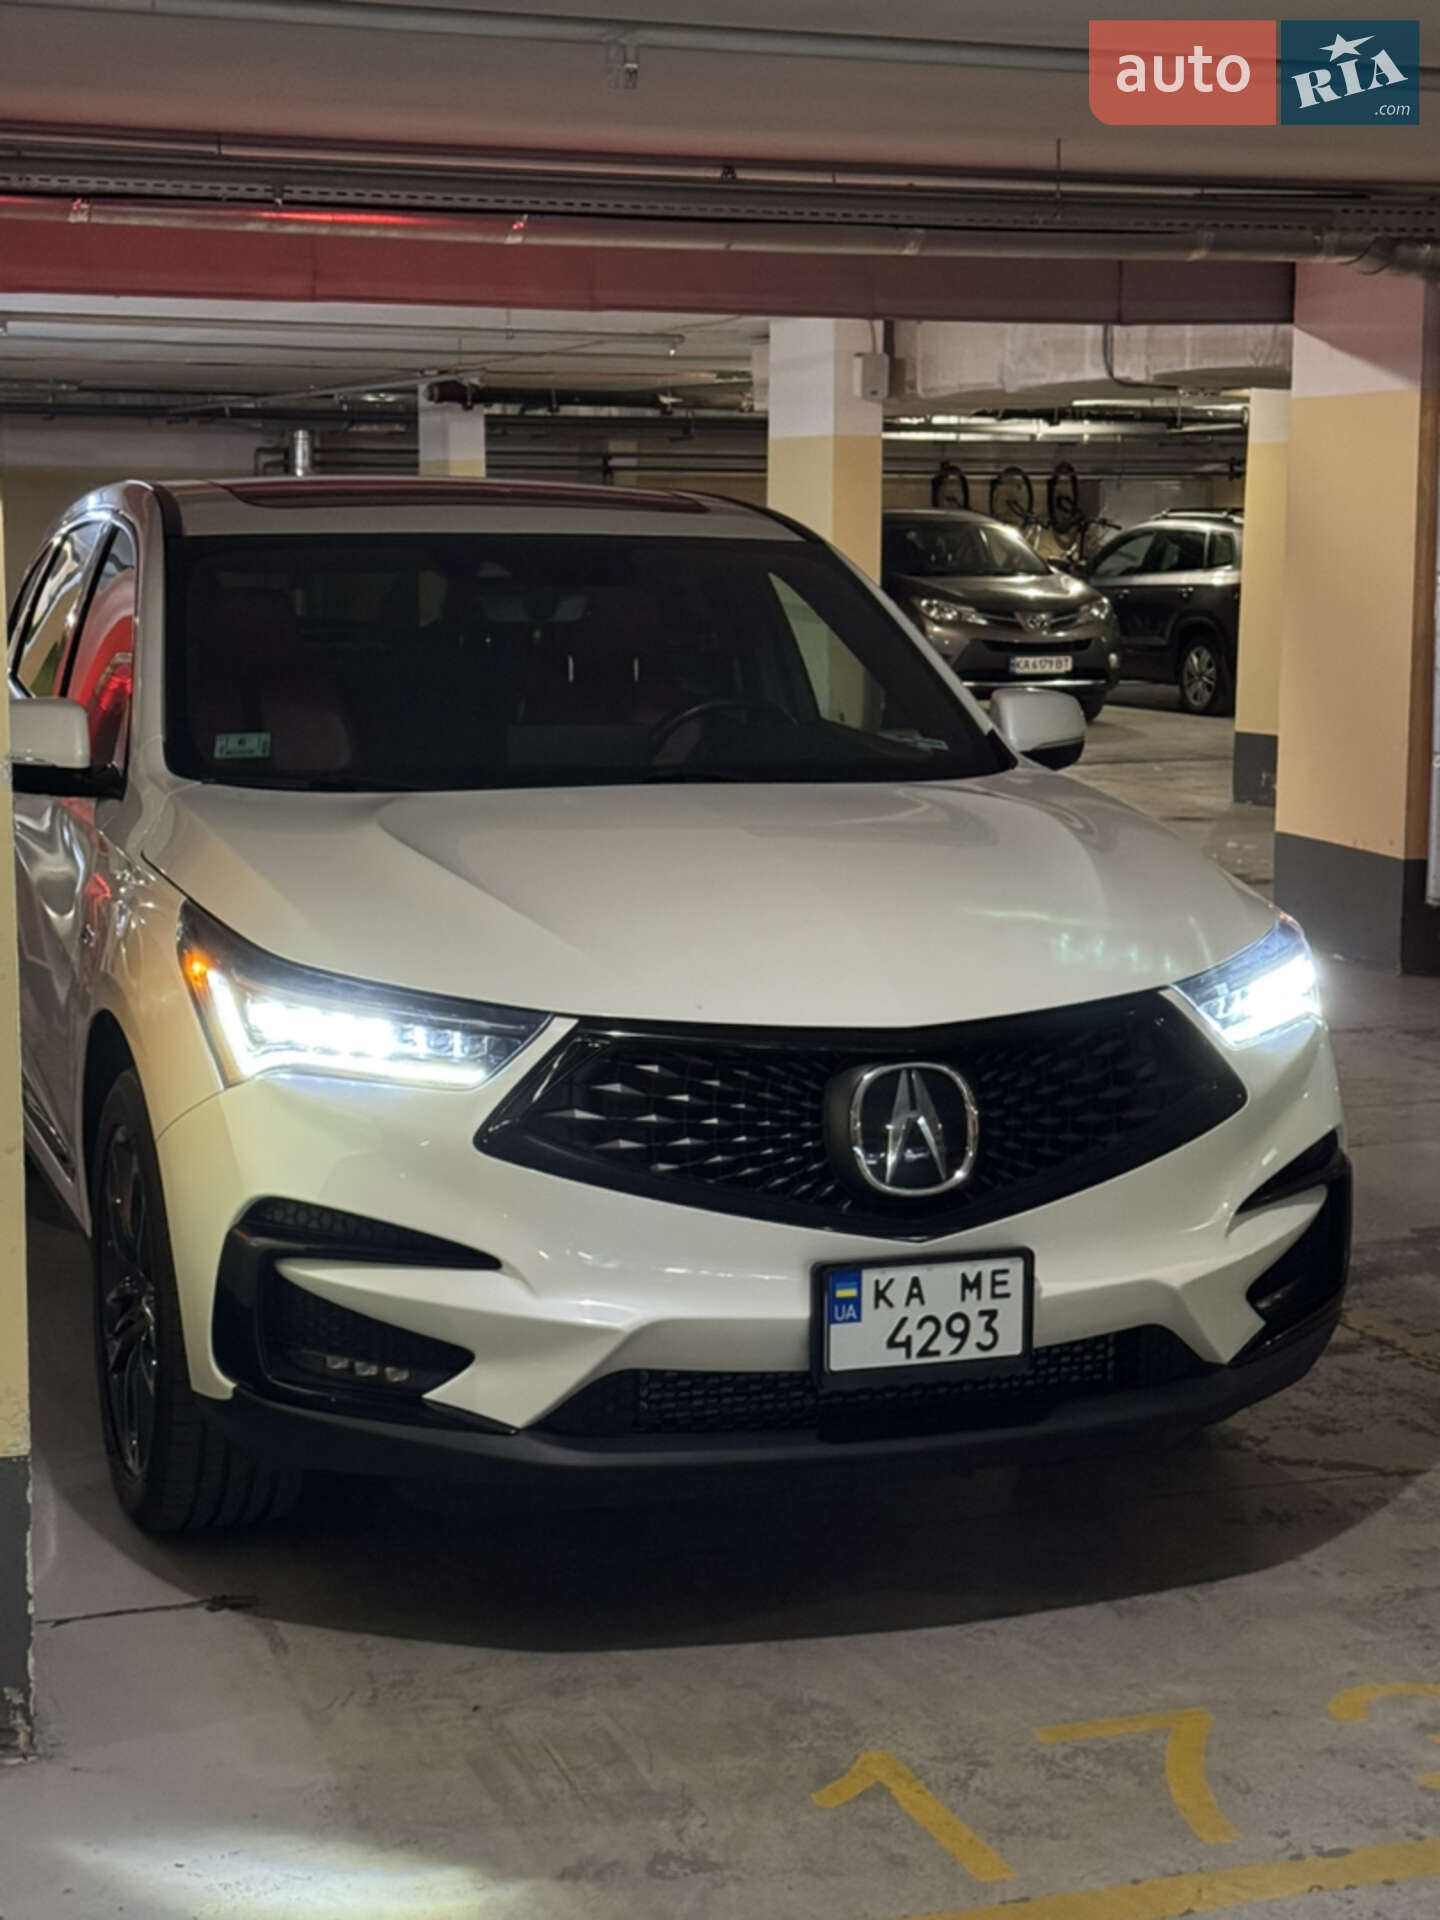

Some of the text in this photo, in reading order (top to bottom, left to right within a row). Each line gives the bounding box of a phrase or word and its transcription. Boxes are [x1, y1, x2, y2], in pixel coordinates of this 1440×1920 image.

[874, 1269, 1011, 1310] KA ME
[834, 1304, 858, 1321] UA
[886, 1309, 999, 1359] 4293
